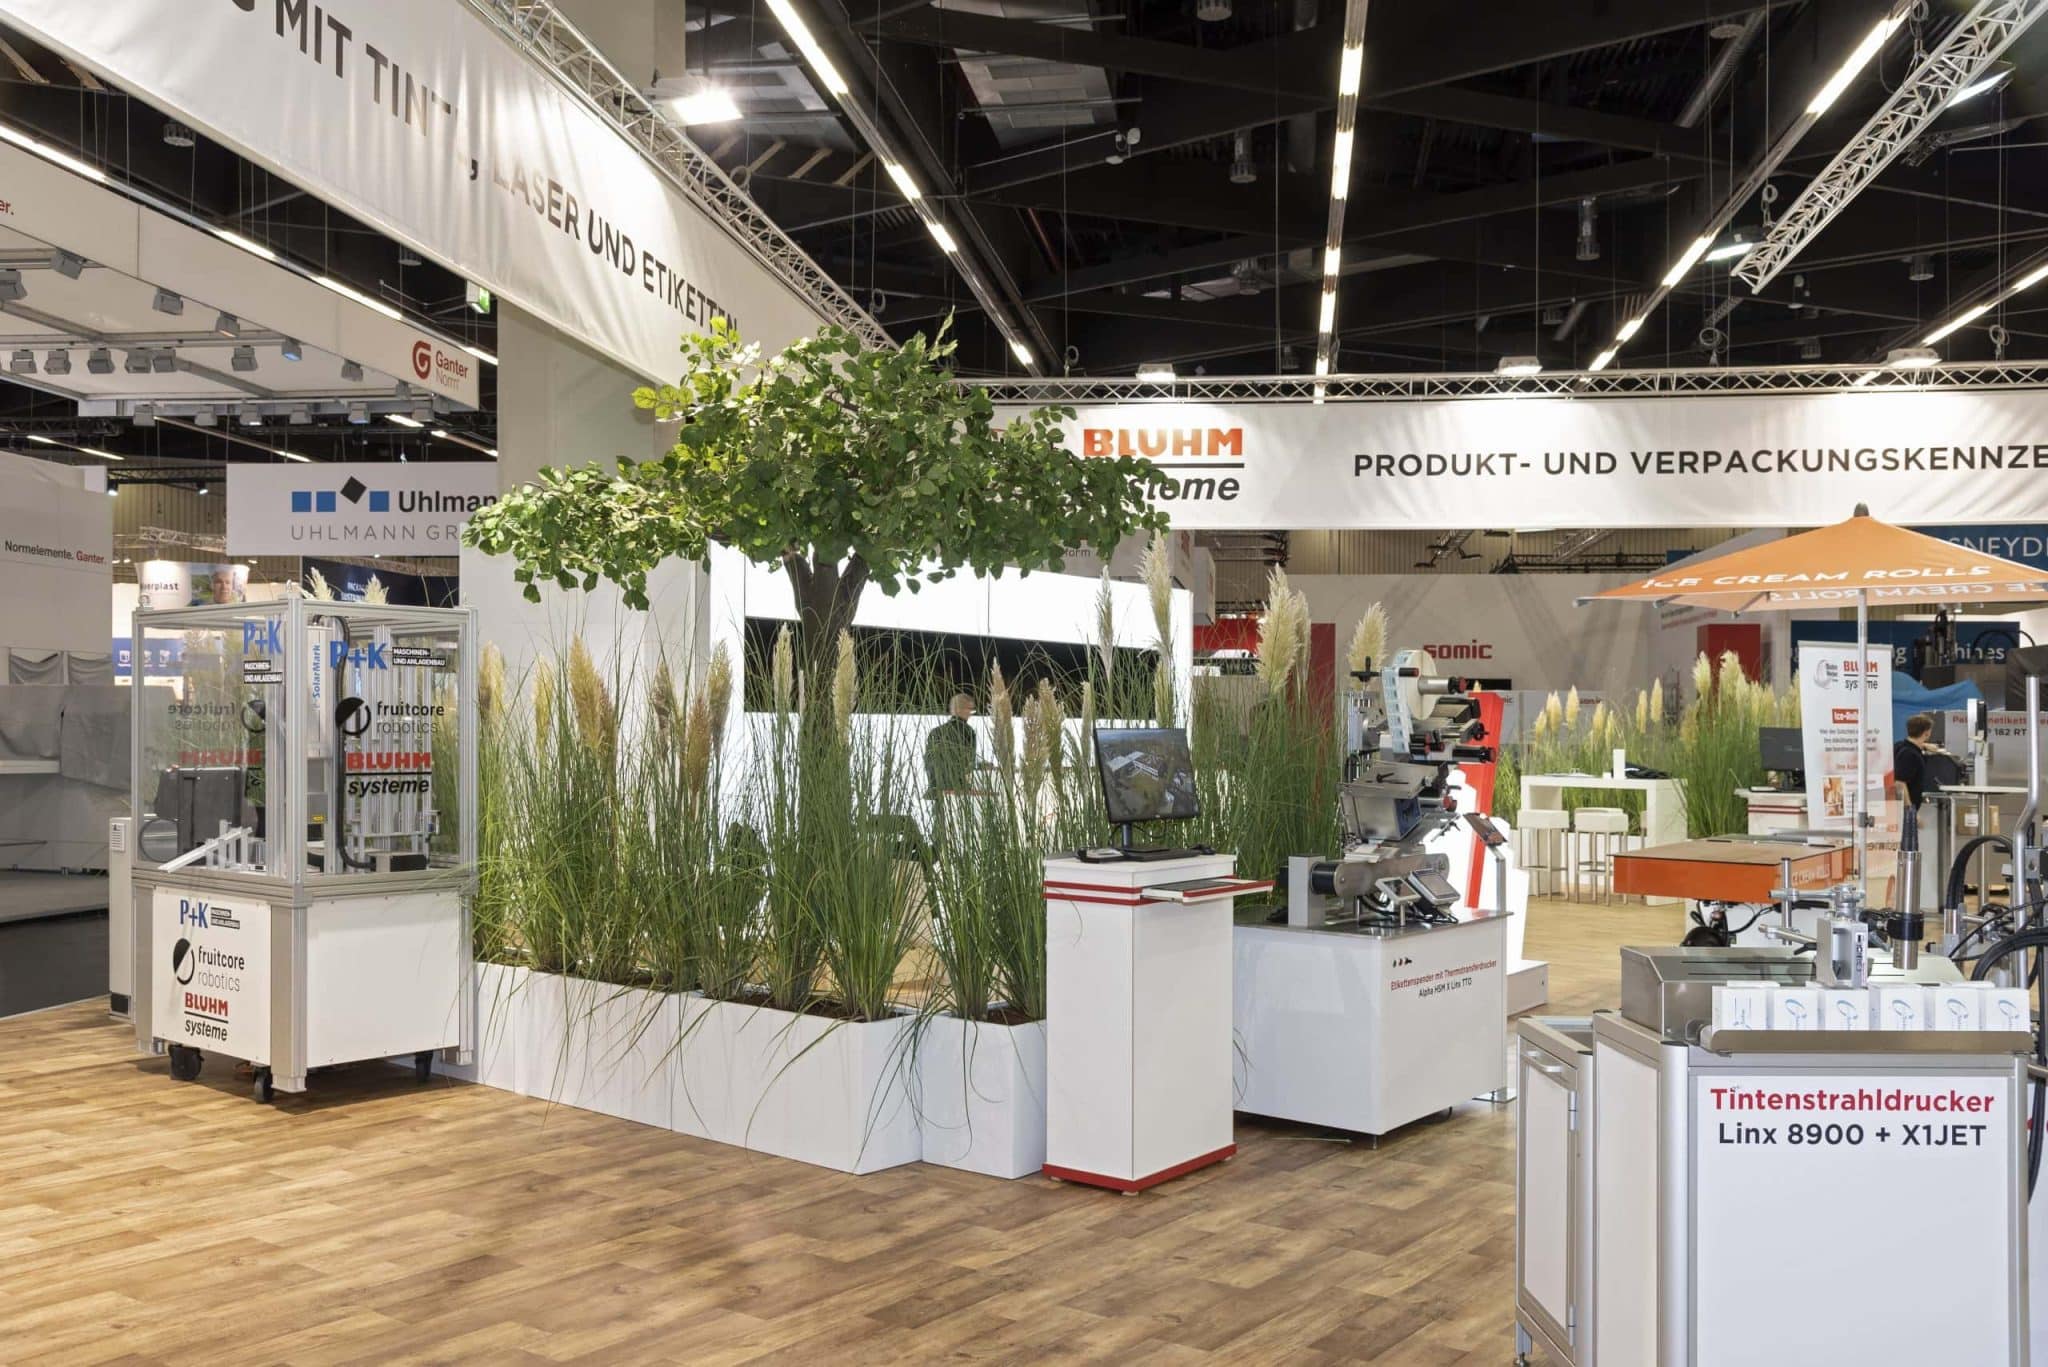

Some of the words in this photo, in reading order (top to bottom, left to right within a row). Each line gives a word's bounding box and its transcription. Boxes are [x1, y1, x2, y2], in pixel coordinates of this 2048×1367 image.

[275, 0, 352, 79] MIT
[493, 155, 580, 240] LASER
[588, 208, 636, 278] UND
[436, 350, 468, 379] Ganter
[1083, 428, 1243, 457] BLUHM
[1353, 452, 1531, 477] PRODUKT-
[1544, 451, 1618, 476] UND
[1630, 445, 2048, 476] VERPACKUNGSKENNZE
[291, 525, 416, 541] UHLMANN
[1713, 572, 1849, 585] CREAM
[1863, 566, 1993, 580] ROLLS
[243, 620, 282, 655] P+K
[1423, 639, 1492, 659] somic
[329, 641, 388, 670] P+K
[1845, 680, 1878, 691] sysme
[377, 702, 445, 717] fruitcore
[376, 719, 438, 734] robotics
[346, 752, 431, 770] BLUHM
[347, 775, 430, 797] systeme
[179, 900, 209, 929] P+K
[198, 945, 245, 971] fruitcore
[198, 971, 241, 992] robotics
[185, 992, 229, 1017] BLUHM
[185, 1019, 228, 1041] systeme
[1710, 1088, 1994, 1113] Tintenstrahldrucker
[1718, 1122, 1777, 1145] Linx
[1787, 1123, 1865, 1146] 8900
[1875, 1126, 1891, 1142] +
[1901, 1124, 1987, 1146] X1JET
